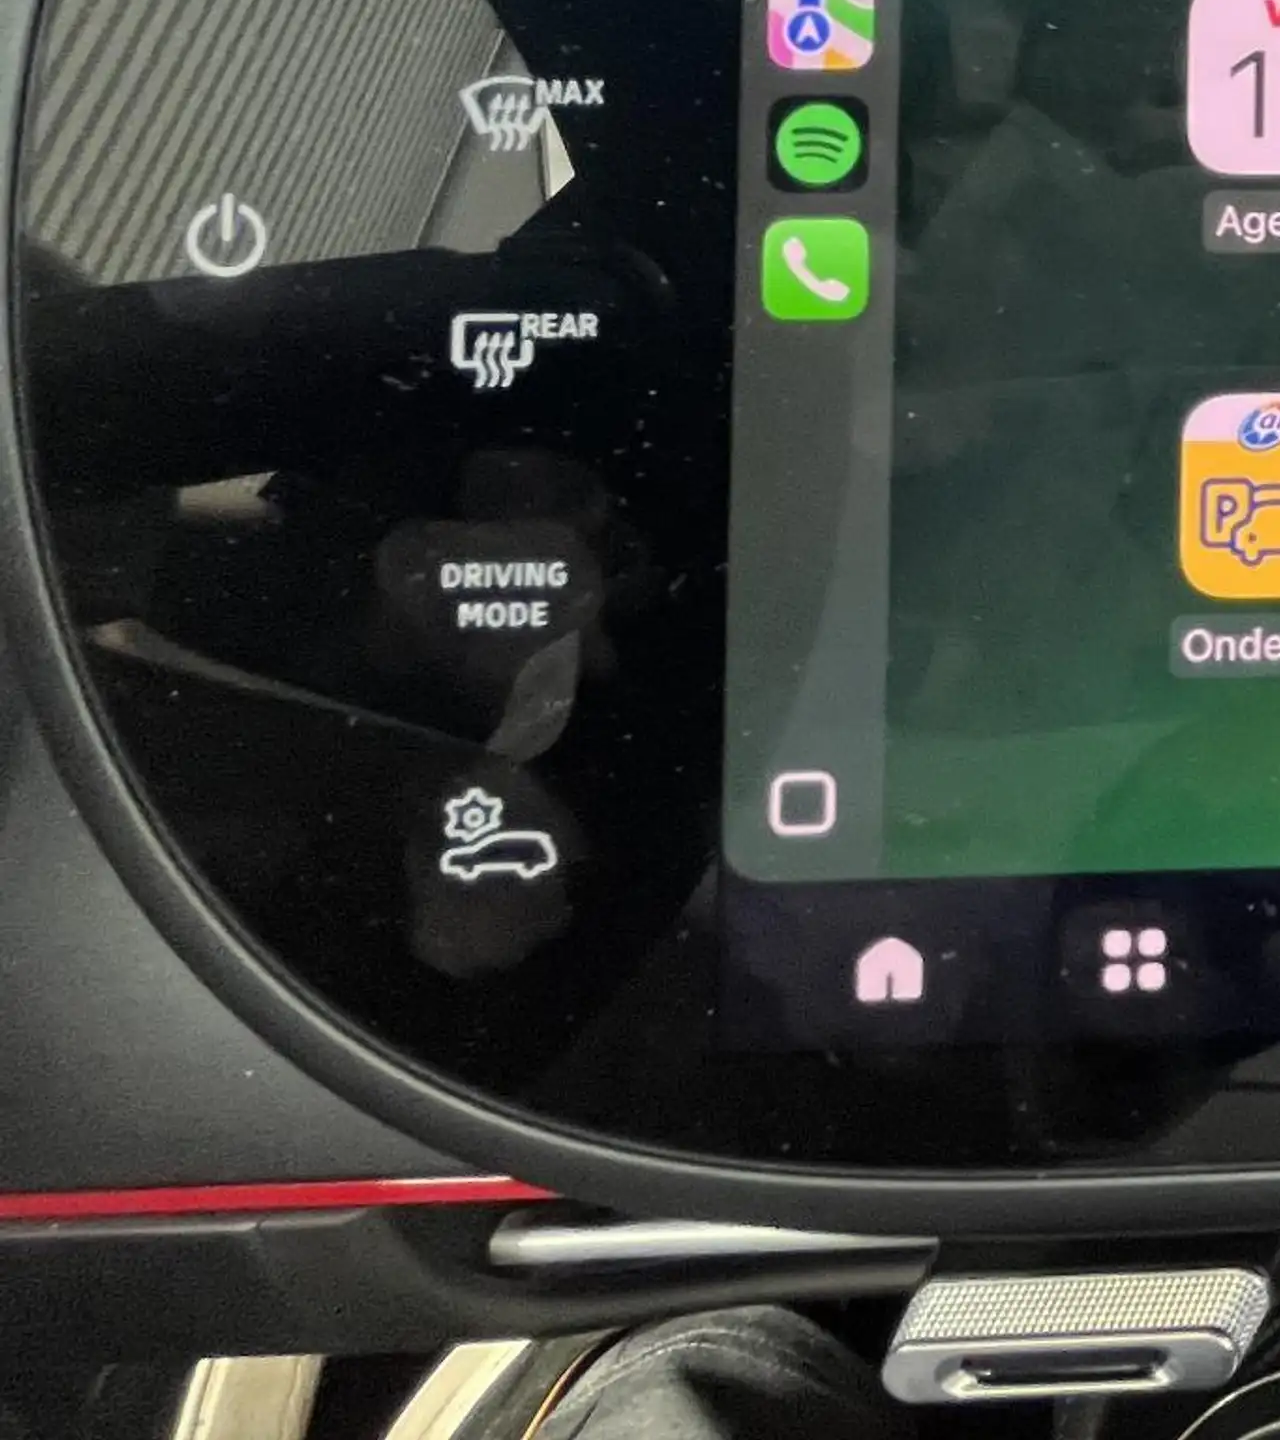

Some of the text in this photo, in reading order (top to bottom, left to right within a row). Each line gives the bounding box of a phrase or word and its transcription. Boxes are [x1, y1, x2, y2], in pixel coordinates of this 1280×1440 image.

[535, 79, 604, 105] MAX
[521, 313, 598, 338] REAR
[440, 561, 569, 589] DRIVING
[457, 602, 549, 628] MODE
